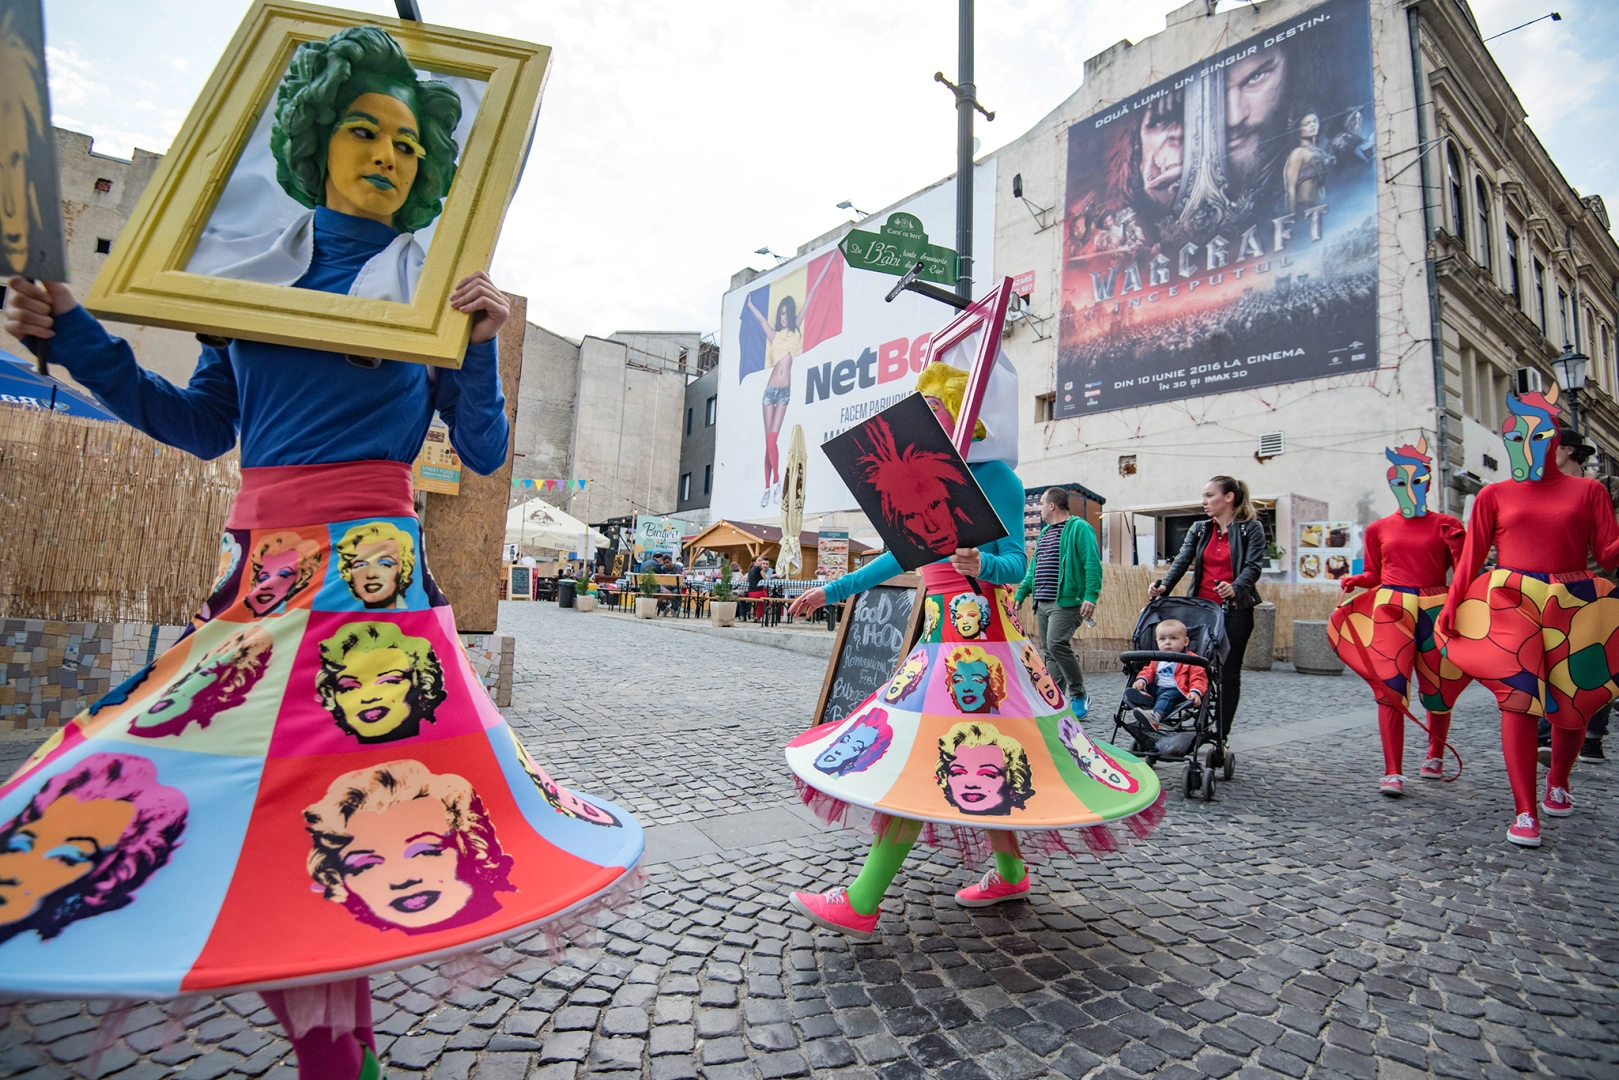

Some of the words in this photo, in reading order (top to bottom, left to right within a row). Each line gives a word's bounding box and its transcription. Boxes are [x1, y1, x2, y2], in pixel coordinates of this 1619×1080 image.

[1095, 104, 1130, 128] DOUĂ
[1133, 90, 1169, 110] LUMI.
[1174, 75, 1194, 91] UN
[1200, 45, 1258, 78] SINGUR
[1264, 14, 1331, 48] DESTIN.
[850, 243, 862, 255] De
[863, 240, 898, 264] 135
[1089, 203, 1329, 303] WARCRAFT
[805, 332, 933, 405] NetBe
[1114, 379, 1134, 389] DIN
[1137, 375, 1150, 385] 10
[1152, 369, 1186, 382] IUNIE
[1190, 362, 1221, 375] 2016
[1223, 359, 1242, 369] LA
[1247, 347, 1306, 364] CINEMA
[1172, 380, 1187, 389] 3D
[1204, 372, 1231, 384] IMAX
[1232, 370, 1248, 379] 3D
